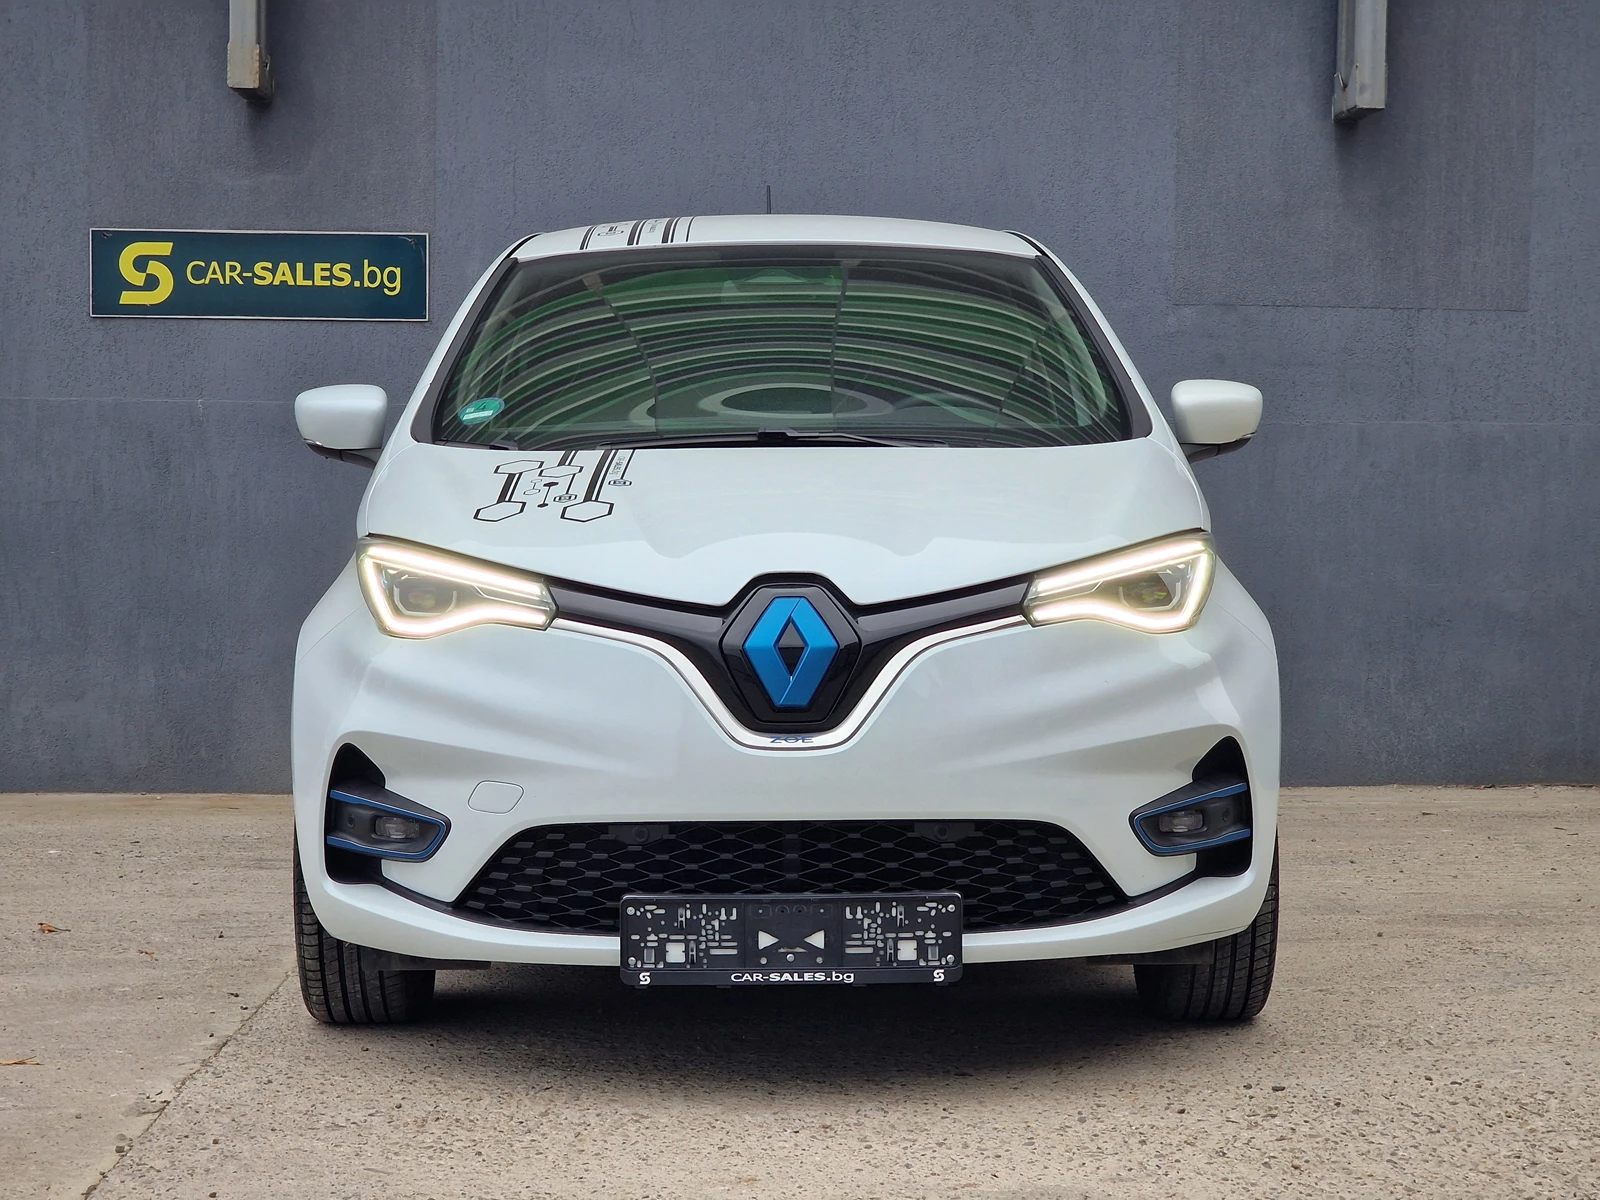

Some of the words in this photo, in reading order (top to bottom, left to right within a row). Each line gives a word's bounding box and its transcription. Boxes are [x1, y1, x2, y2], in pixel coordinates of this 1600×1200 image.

[186, 259, 402, 296] CAR-SALES.bg
[769, 735, 814, 744] ZOE
[730, 971, 855, 983] CAR-SALES.bg
